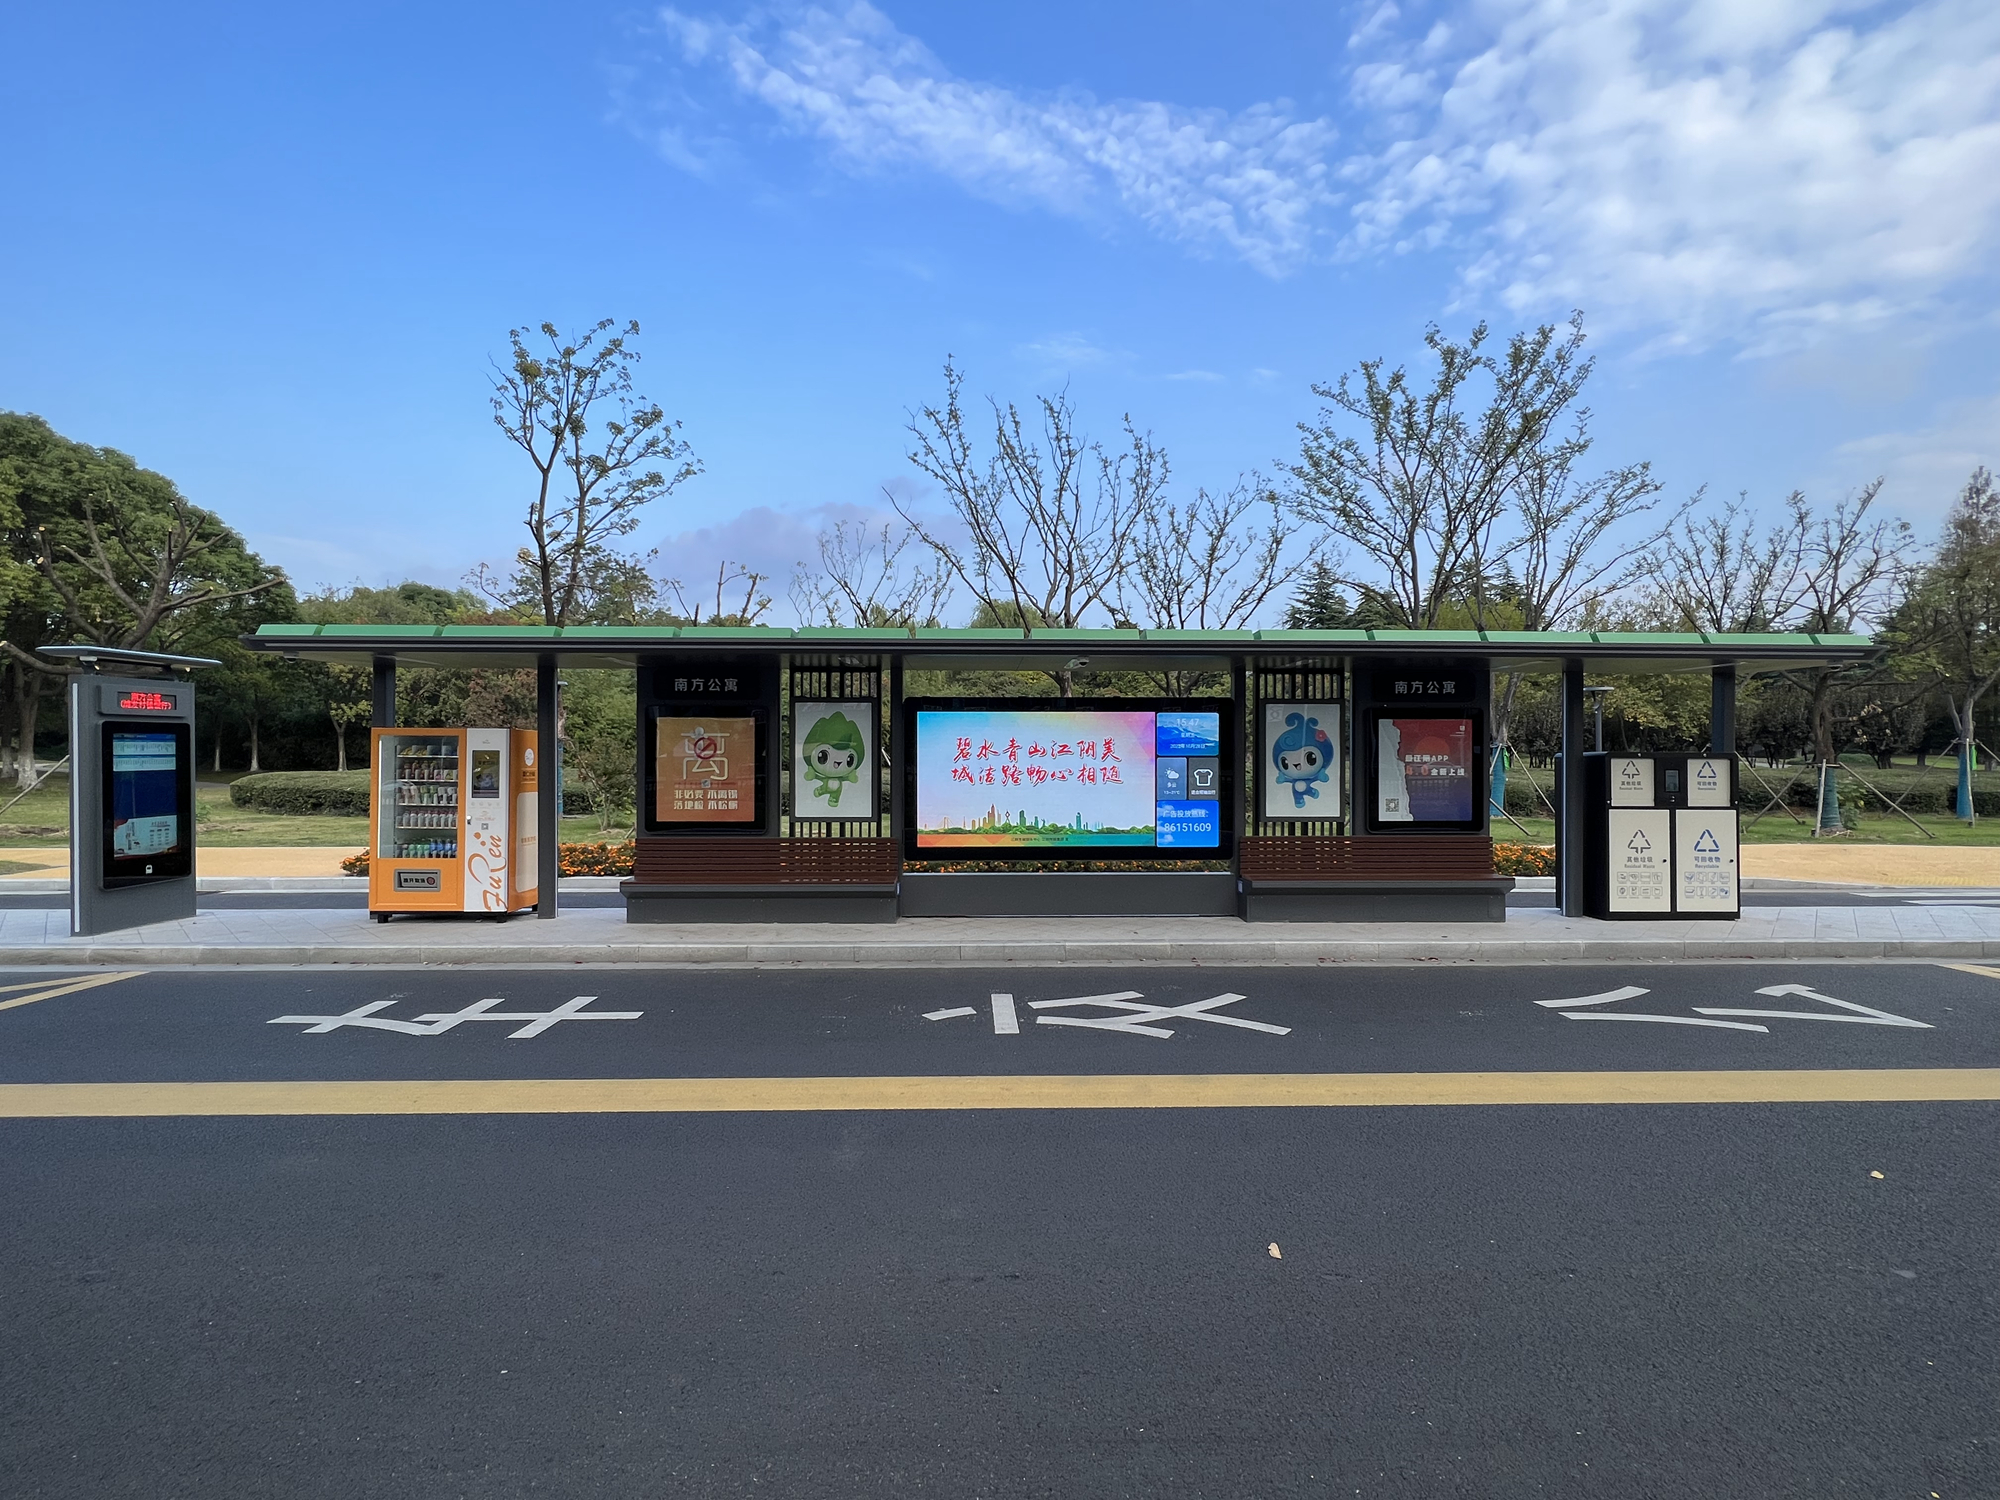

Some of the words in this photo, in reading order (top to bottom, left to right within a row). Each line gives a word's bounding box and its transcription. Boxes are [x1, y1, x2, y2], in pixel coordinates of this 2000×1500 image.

[674, 678, 738, 692] 南方公寓
[1395, 681, 1456, 694] 南方公寓
[953, 736, 1122, 762] 碧水青山江阴美
[951, 763, 1123, 787] 城洁路畅心相随
[1164, 822, 1212, 832] 86151609
